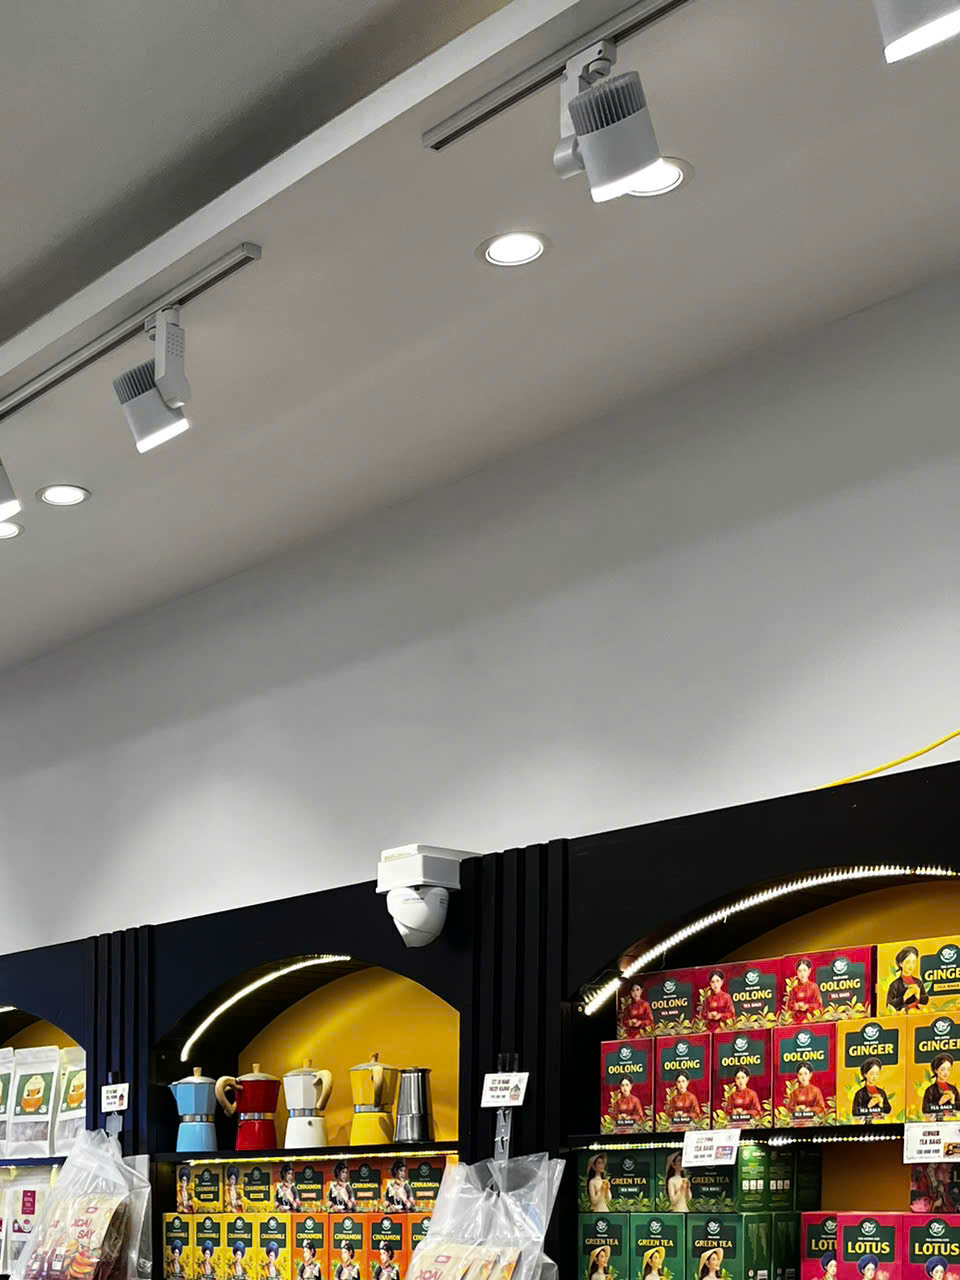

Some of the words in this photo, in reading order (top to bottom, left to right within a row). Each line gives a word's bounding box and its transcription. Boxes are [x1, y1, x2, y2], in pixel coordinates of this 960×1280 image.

[925, 967, 960, 981] GINGE
[820, 979, 861, 991] OOLONG
[733, 990, 772, 1001] OOLONG
[652, 998, 688, 1010] OOLONG
[849, 1044, 894, 1057] GINGER
[722, 1055, 761, 1066] OOLONG
[783, 1051, 825, 1062] OOLONG
[608, 1064, 643, 1074] OOLONG
[664, 1060, 700, 1070] OOLONG
[718, 1240, 732, 1248] TEA
[848, 1242, 890, 1254] LOTUS
[914, 1243, 960, 1255] LOTUS
